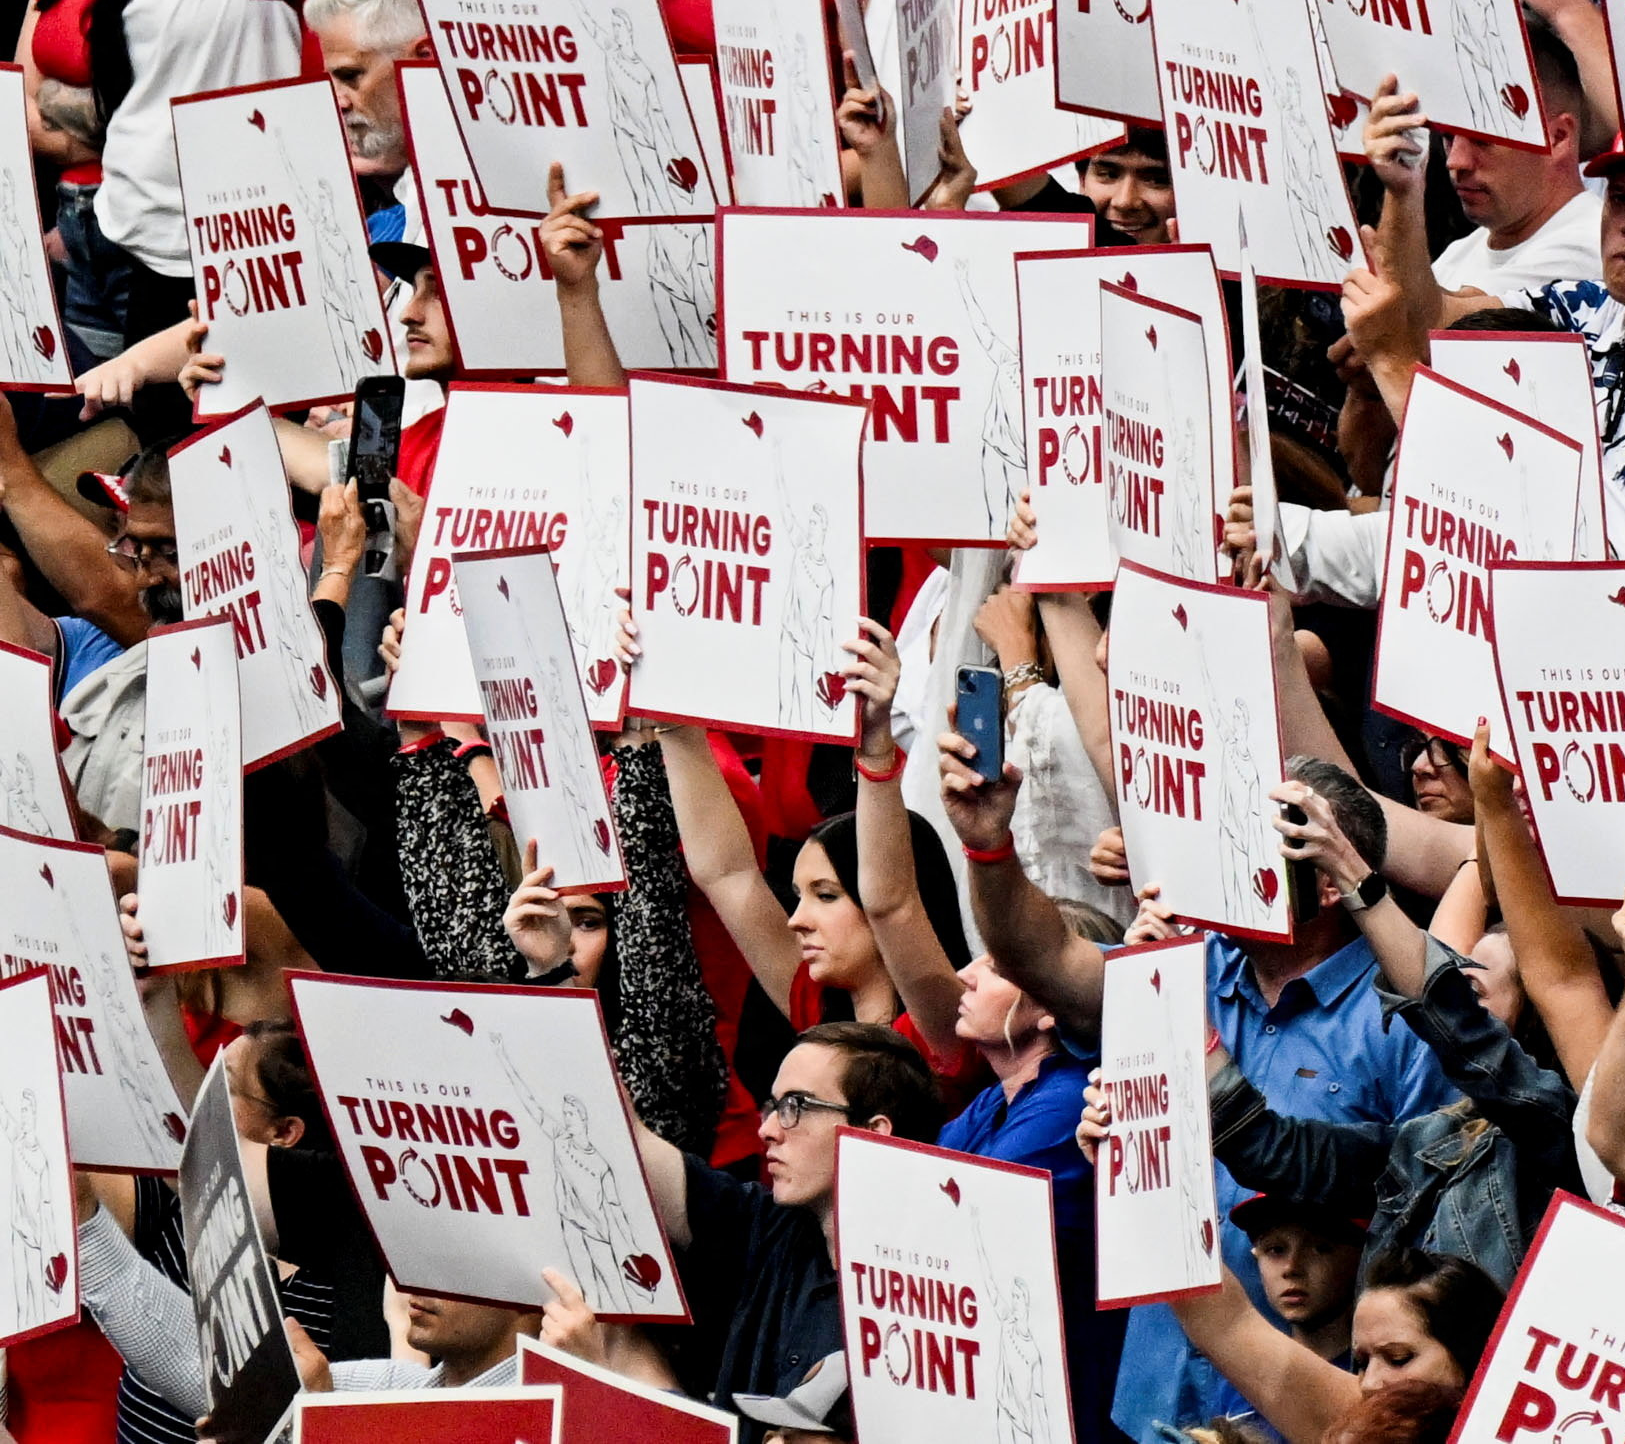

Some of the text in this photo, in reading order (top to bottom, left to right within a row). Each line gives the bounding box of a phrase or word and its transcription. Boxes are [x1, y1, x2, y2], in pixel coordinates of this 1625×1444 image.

[366, 1078, 471, 1098] THIS IS OUR
[337, 1096, 520, 1149] TURNING
